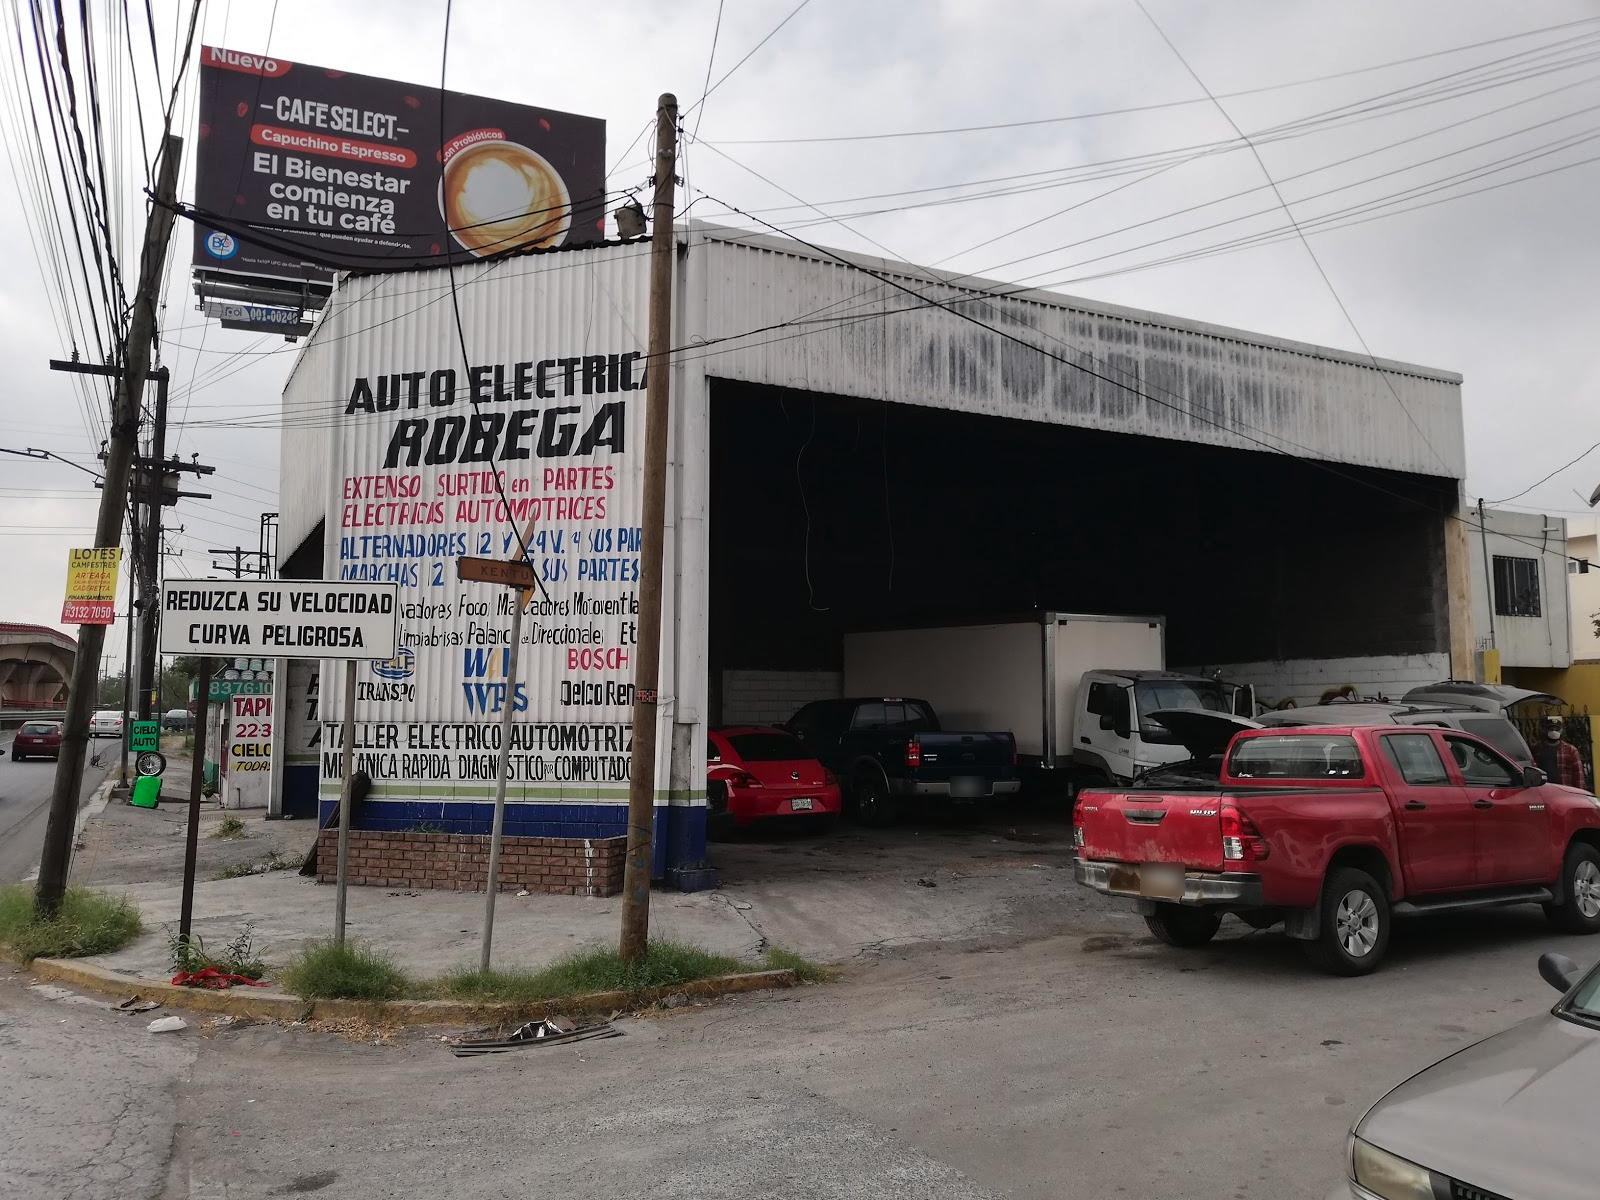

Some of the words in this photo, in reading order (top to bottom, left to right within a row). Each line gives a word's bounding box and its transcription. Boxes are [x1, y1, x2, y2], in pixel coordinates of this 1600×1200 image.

[211, 47, 277, 73] Nuevo
[330, 104, 398, 140] SELECT
[261, 129, 338, 153] Capuchino
[341, 143, 406, 164] Espresso
[453, 131, 503, 150] Probióticos
[253, 152, 277, 175] El
[285, 157, 411, 194] Bienestar
[269, 182, 395, 215] comienza
[266, 203, 299, 222] en
[306, 204, 333, 227] tu
[339, 210, 396, 235] café
[345, 369, 456, 414] AUTO
[383, 401, 625, 469] ROBEGA
[344, 475, 421, 499] EXTENSO
[437, 470, 505, 497] SURTIDO
[511, 477, 529, 493] en
[543, 466, 614, 490] PARTES
[341, 501, 444, 528] ELECTRICAS
[455, 496, 606, 523] AUTOMOTRICES
[74, 549, 116, 560] LOTES
[340, 532, 467, 559] ALTERNADORES
[589, 528, 612, 553] SUS
[341, 562, 418, 587] MARCHAS
[542, 558, 567, 583] SUS
[578, 558, 639, 582] PARTES
[70, 606, 90, 618] 3132
[91, 606, 111, 619] 7050
[166, 590, 249, 611] REDUZCA
[257, 591, 281, 612] SU
[290, 592, 393, 614] VELOCIDAD
[189, 623, 250, 645] CURVA
[262, 624, 363, 648] PELIGROSA
[467, 621, 511, 645] Palanc
[532, 621, 604, 645] Direccionale
[568, 647, 629, 670] BOSCH
[358, 682, 415, 702] TRANSPO
[560, 680, 603, 706] Delco
[233, 697, 273, 717] TAPI
[133, 726, 157, 735] CIELO
[133, 738, 156, 747] AUTO
[408, 724, 501, 750] ELECTRICO
[323, 752, 398, 779] MEANICA
[402, 753, 451, 779] RAPIDA
